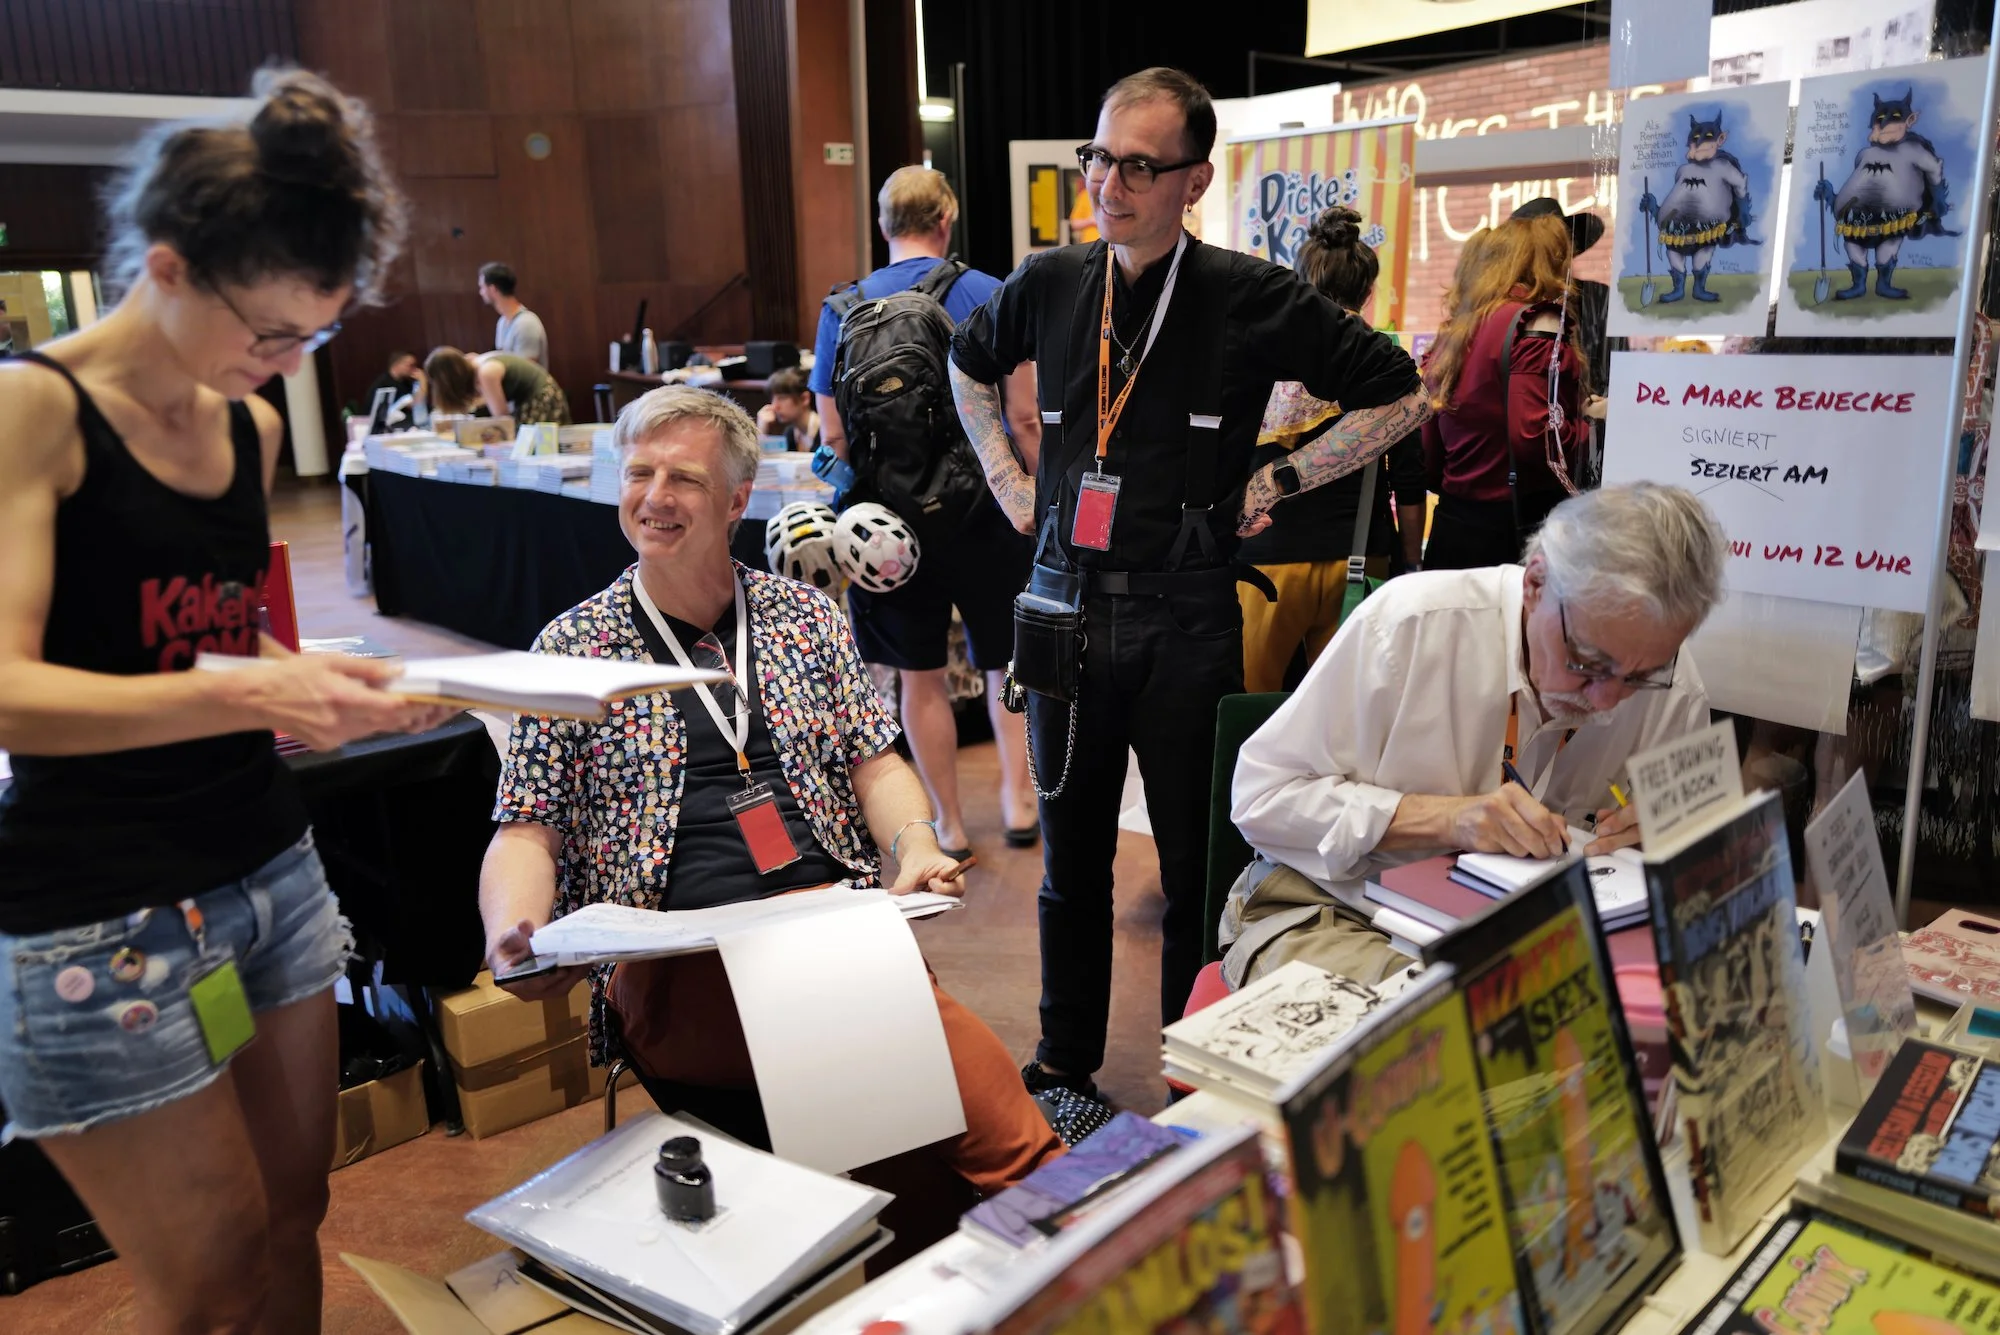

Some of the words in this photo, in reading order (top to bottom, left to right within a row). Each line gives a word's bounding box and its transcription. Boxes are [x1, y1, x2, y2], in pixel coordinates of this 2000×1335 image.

[1814, 98, 1839, 110] When
[1815, 111, 1849, 121] Batman
[1636, 150, 1673, 161] Batman
[1260, 173, 1339, 223] Dicke
[1682, 383, 1763, 409] MARK
[1775, 386, 1916, 413] BENECKE
[1682, 426, 1777, 451] SIGNIERT
[1690, 458, 1778, 483] SEZIERT
[1783, 465, 1829, 485] AM
[1763, 542, 1803, 564] UM
[1813, 545, 1844, 567] 12
[1855, 550, 1912, 576] UHR
